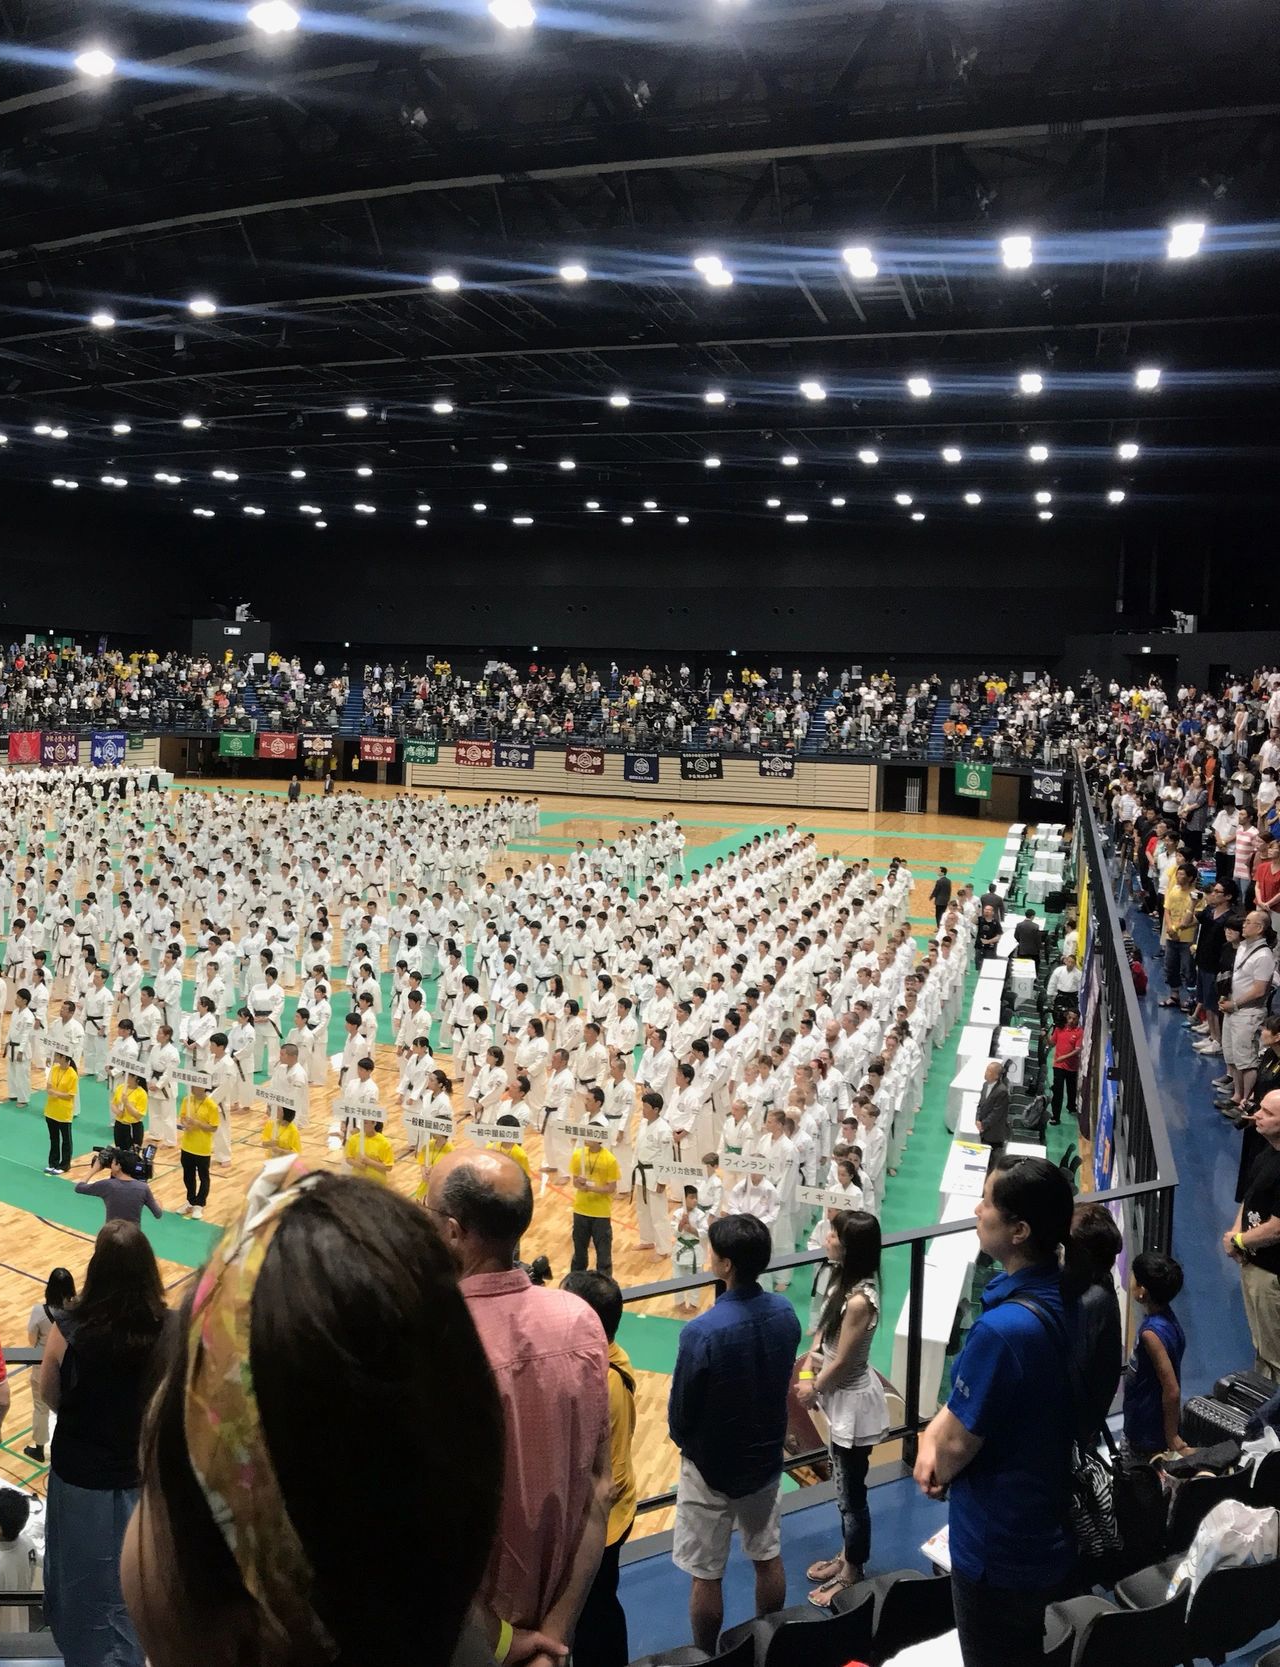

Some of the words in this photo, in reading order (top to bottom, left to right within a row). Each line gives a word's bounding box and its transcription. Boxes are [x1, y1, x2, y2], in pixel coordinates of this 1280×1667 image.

[470, 1128, 520, 1139] 一般中量級の部
[557, 1125, 609, 1139] 一般重量級の部
[658, 1165, 703, 1177] アメリカ合衆国
[723, 1158, 776, 1171] フィンランド
[801, 1192, 852, 1206] イギリス
